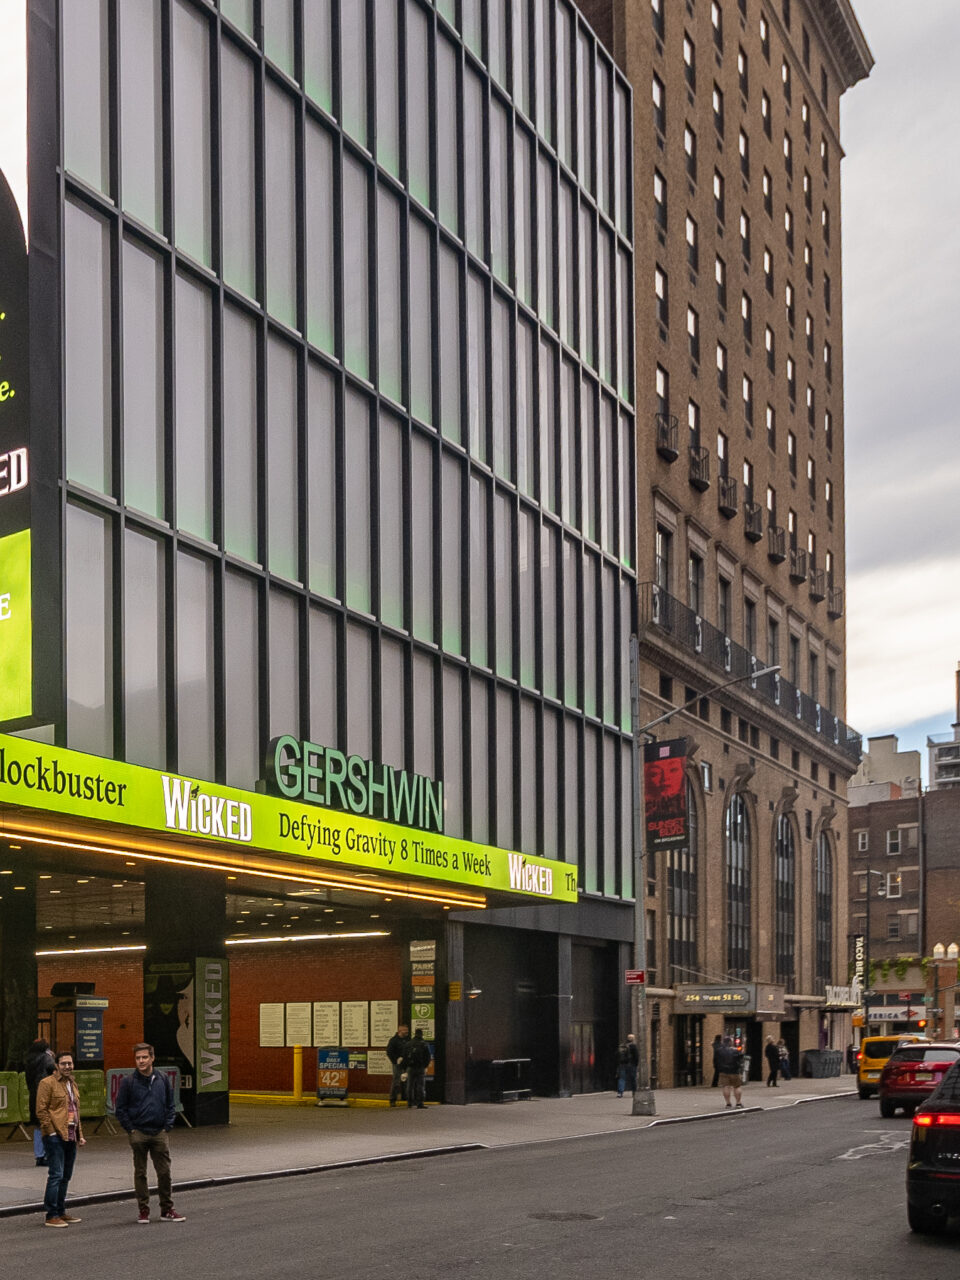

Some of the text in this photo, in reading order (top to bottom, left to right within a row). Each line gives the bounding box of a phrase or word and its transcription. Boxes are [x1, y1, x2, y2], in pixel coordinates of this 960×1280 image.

[161, 775, 253, 842] WICKED
[278, 812, 341, 856] Defying
[345, 826, 396, 864] Gravity
[400, 838, 408, 860] 8
[411, 839, 449, 868] Times
[451, 852, 459, 870] a
[462, 851, 492, 876] Week
[507, 852, 553, 896] WICKED
[272, 734, 444, 832] GERSHWIN
[855, 936, 864, 960] TACO
[200, 963, 223, 1087] WICKED
